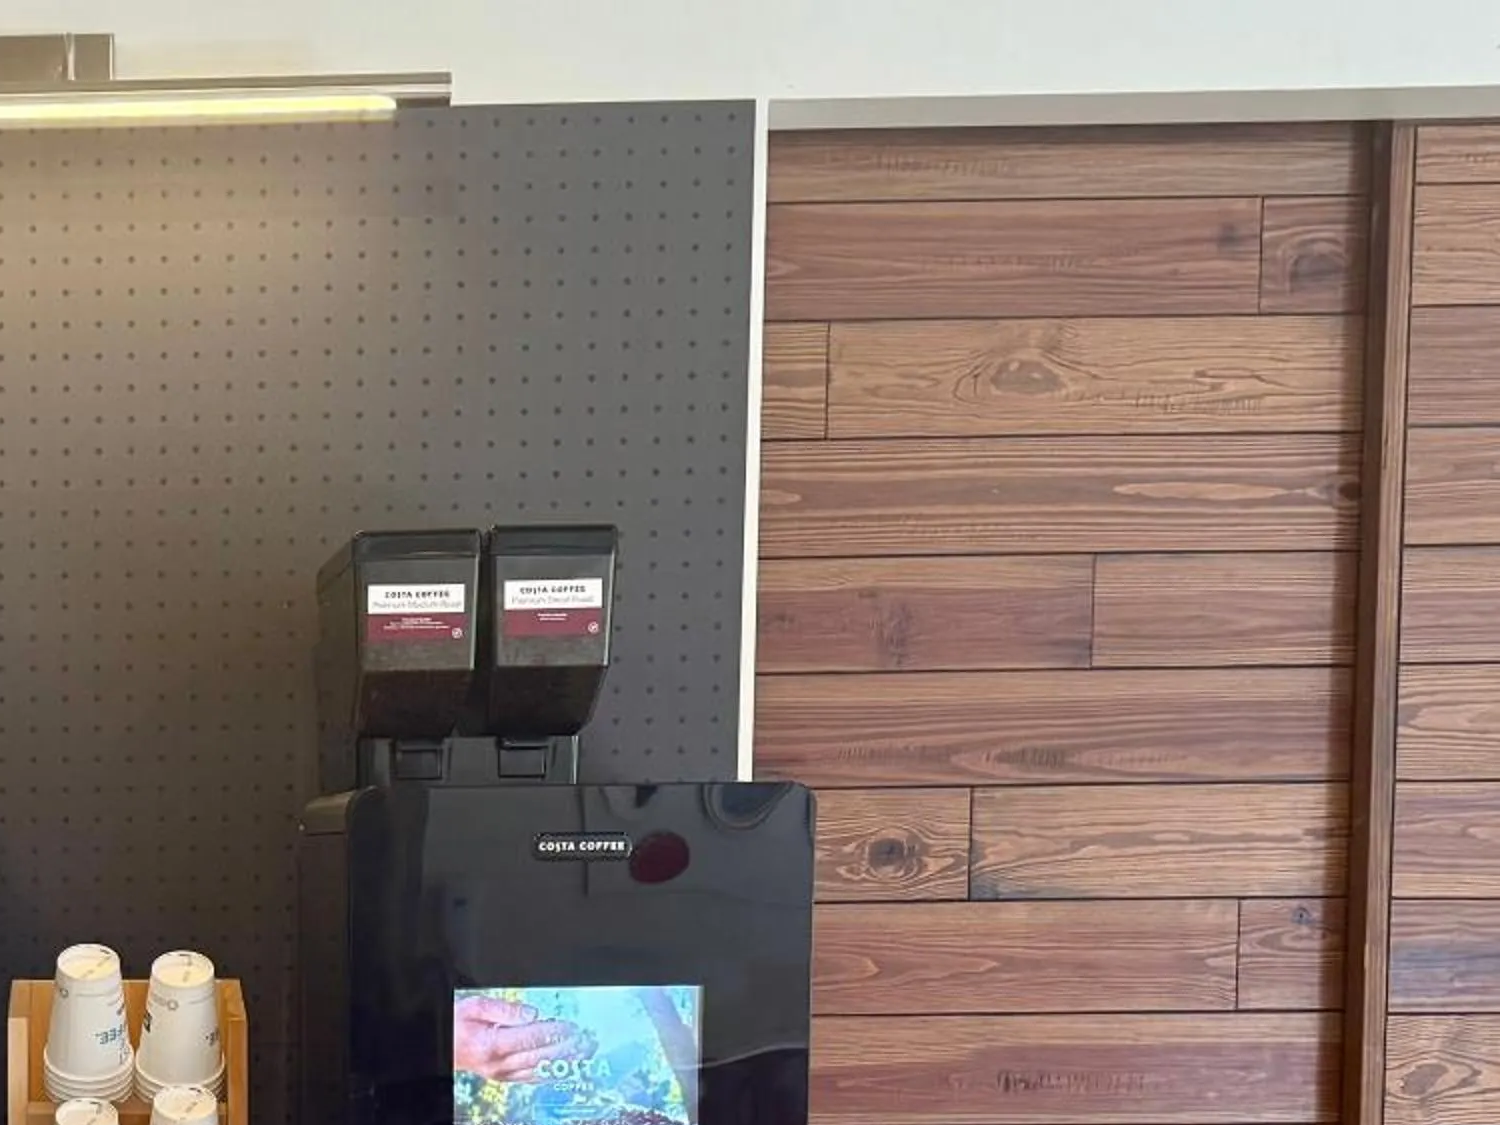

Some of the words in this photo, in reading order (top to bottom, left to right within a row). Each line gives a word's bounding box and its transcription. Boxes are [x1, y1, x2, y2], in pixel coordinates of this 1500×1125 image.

[538, 841, 576, 853] COSTA
[579, 841, 625, 851] COFFEE
[538, 1058, 612, 1082] COSTA
